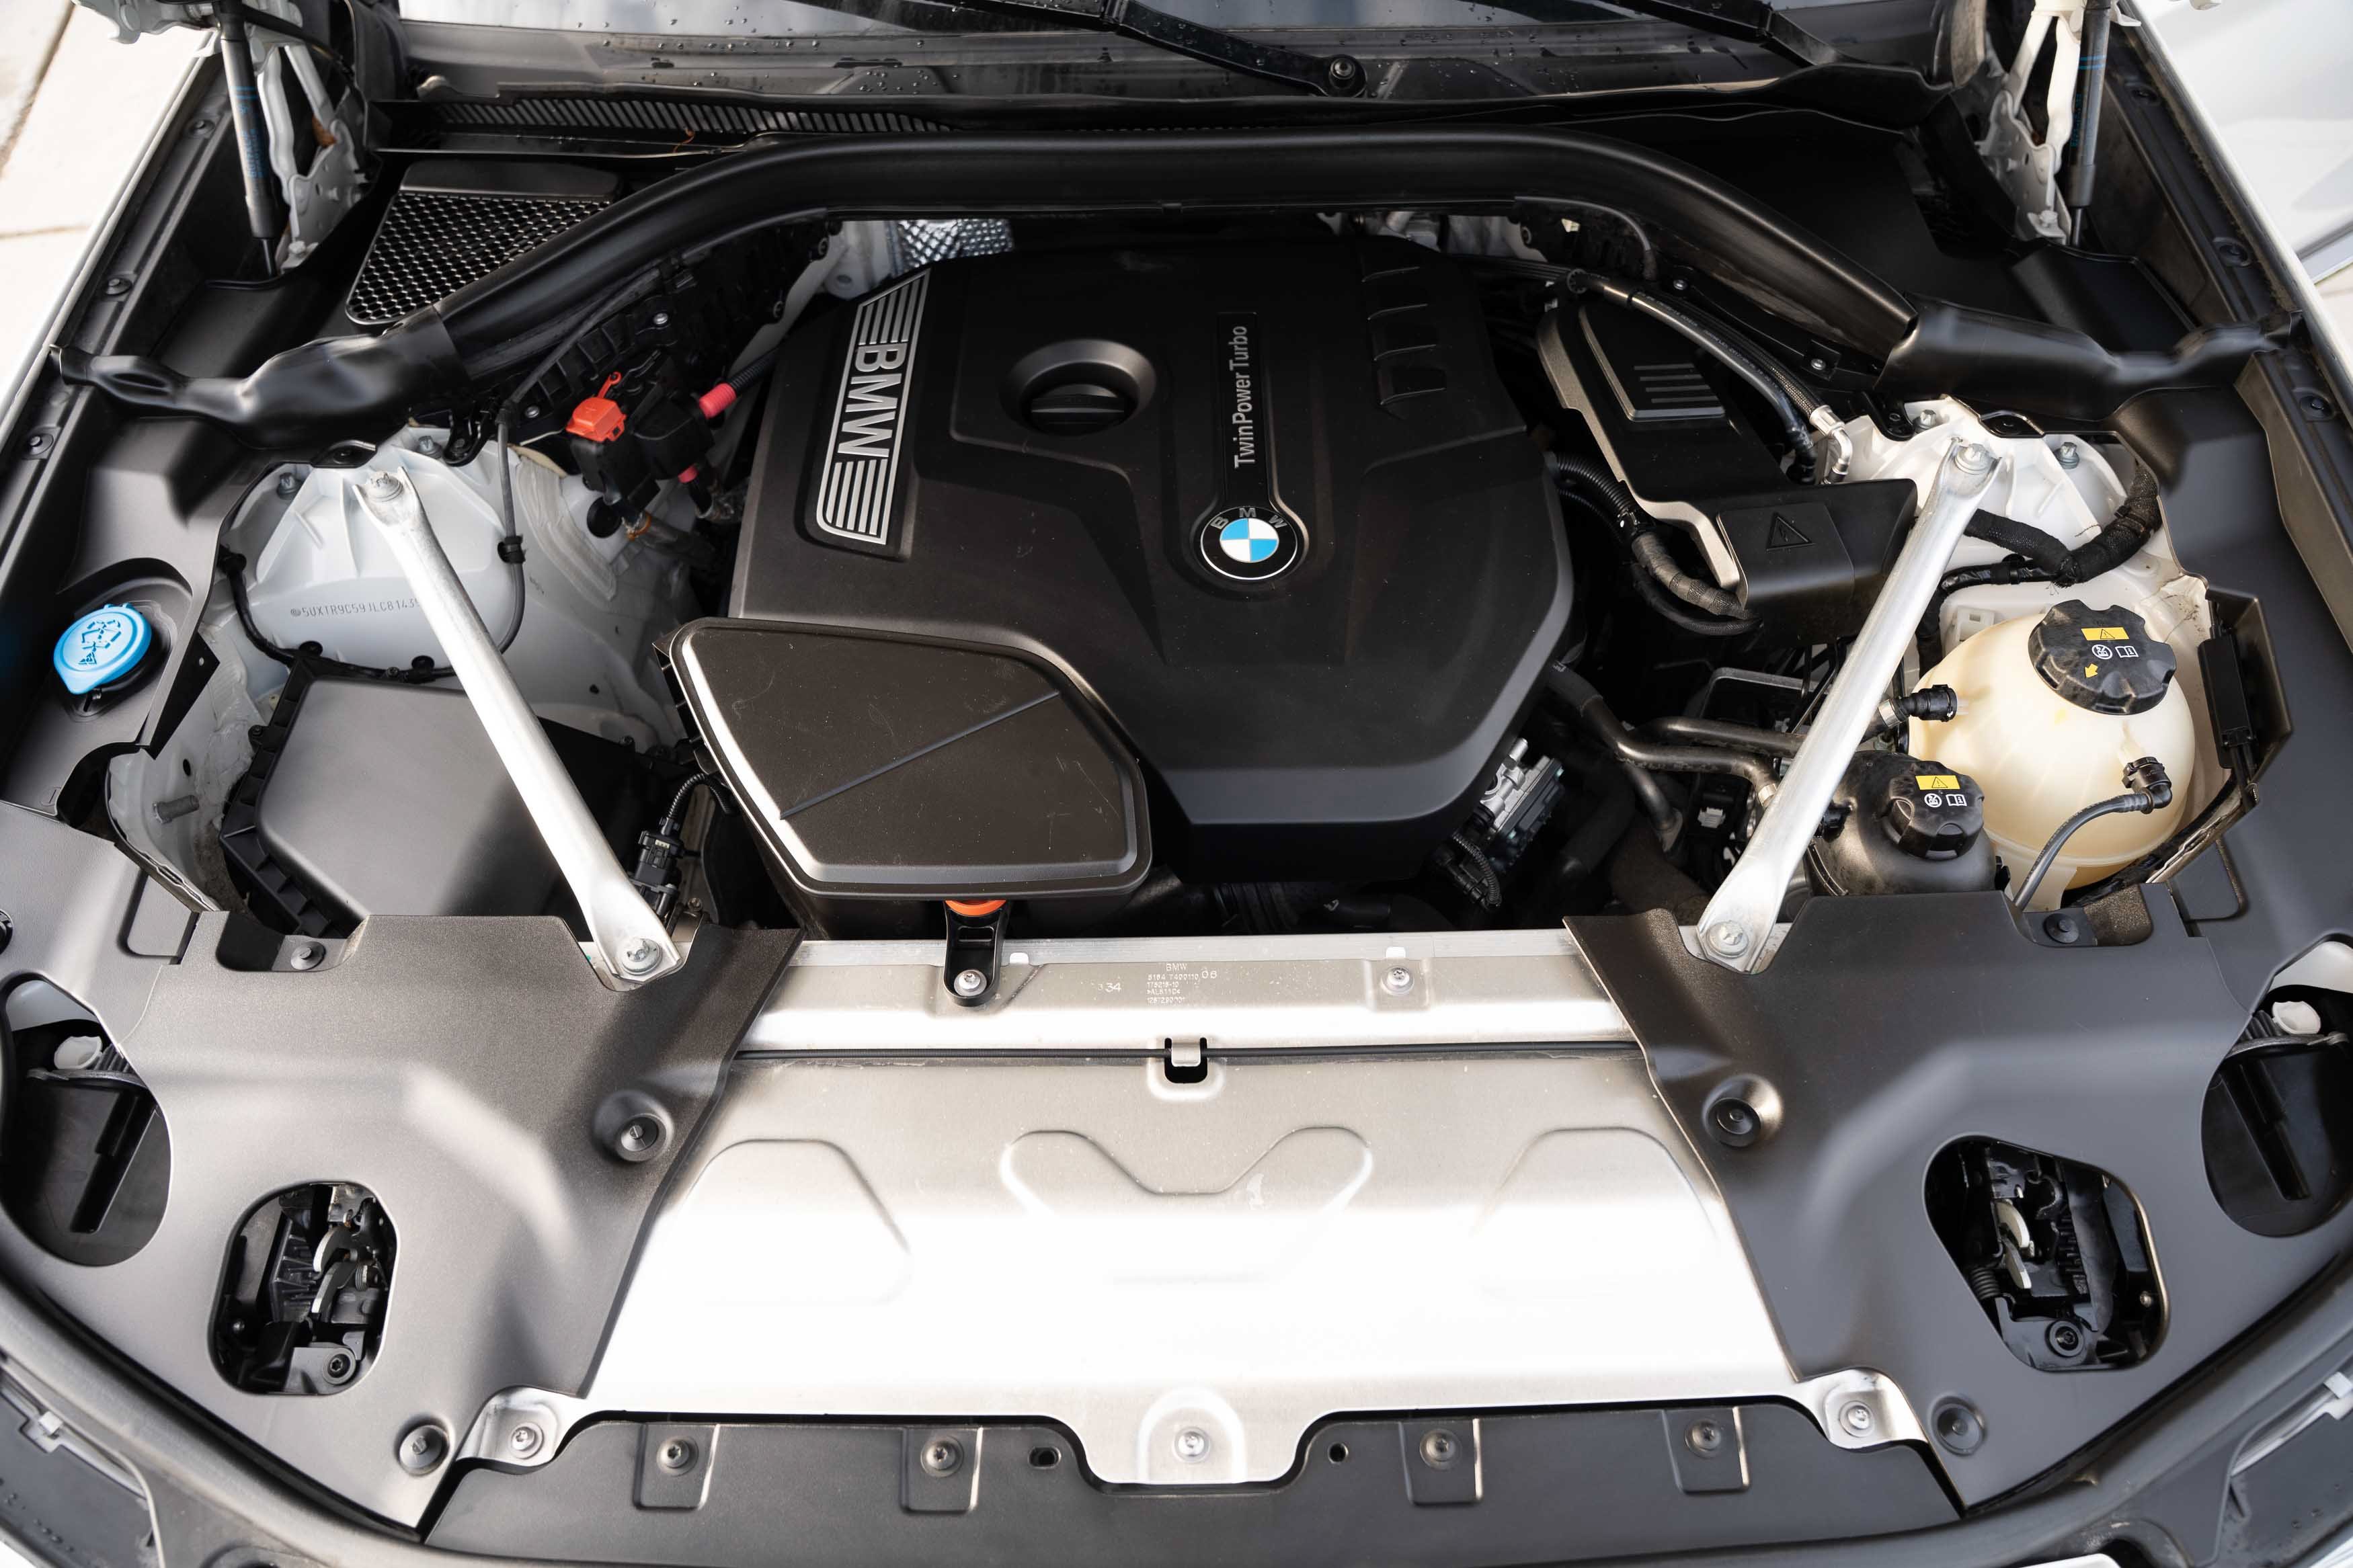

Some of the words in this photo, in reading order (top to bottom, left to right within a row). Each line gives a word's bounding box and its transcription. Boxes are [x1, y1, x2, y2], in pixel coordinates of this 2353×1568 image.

[1228, 326, 1249, 371] Turbo
[838, 343, 908, 458] BMW
[1232, 372, 1255, 469] TwinPower
[1210, 507, 1287, 530] BMW
[1166, 963, 1187, 971] BMW
[1105, 982, 1121, 993] 34
